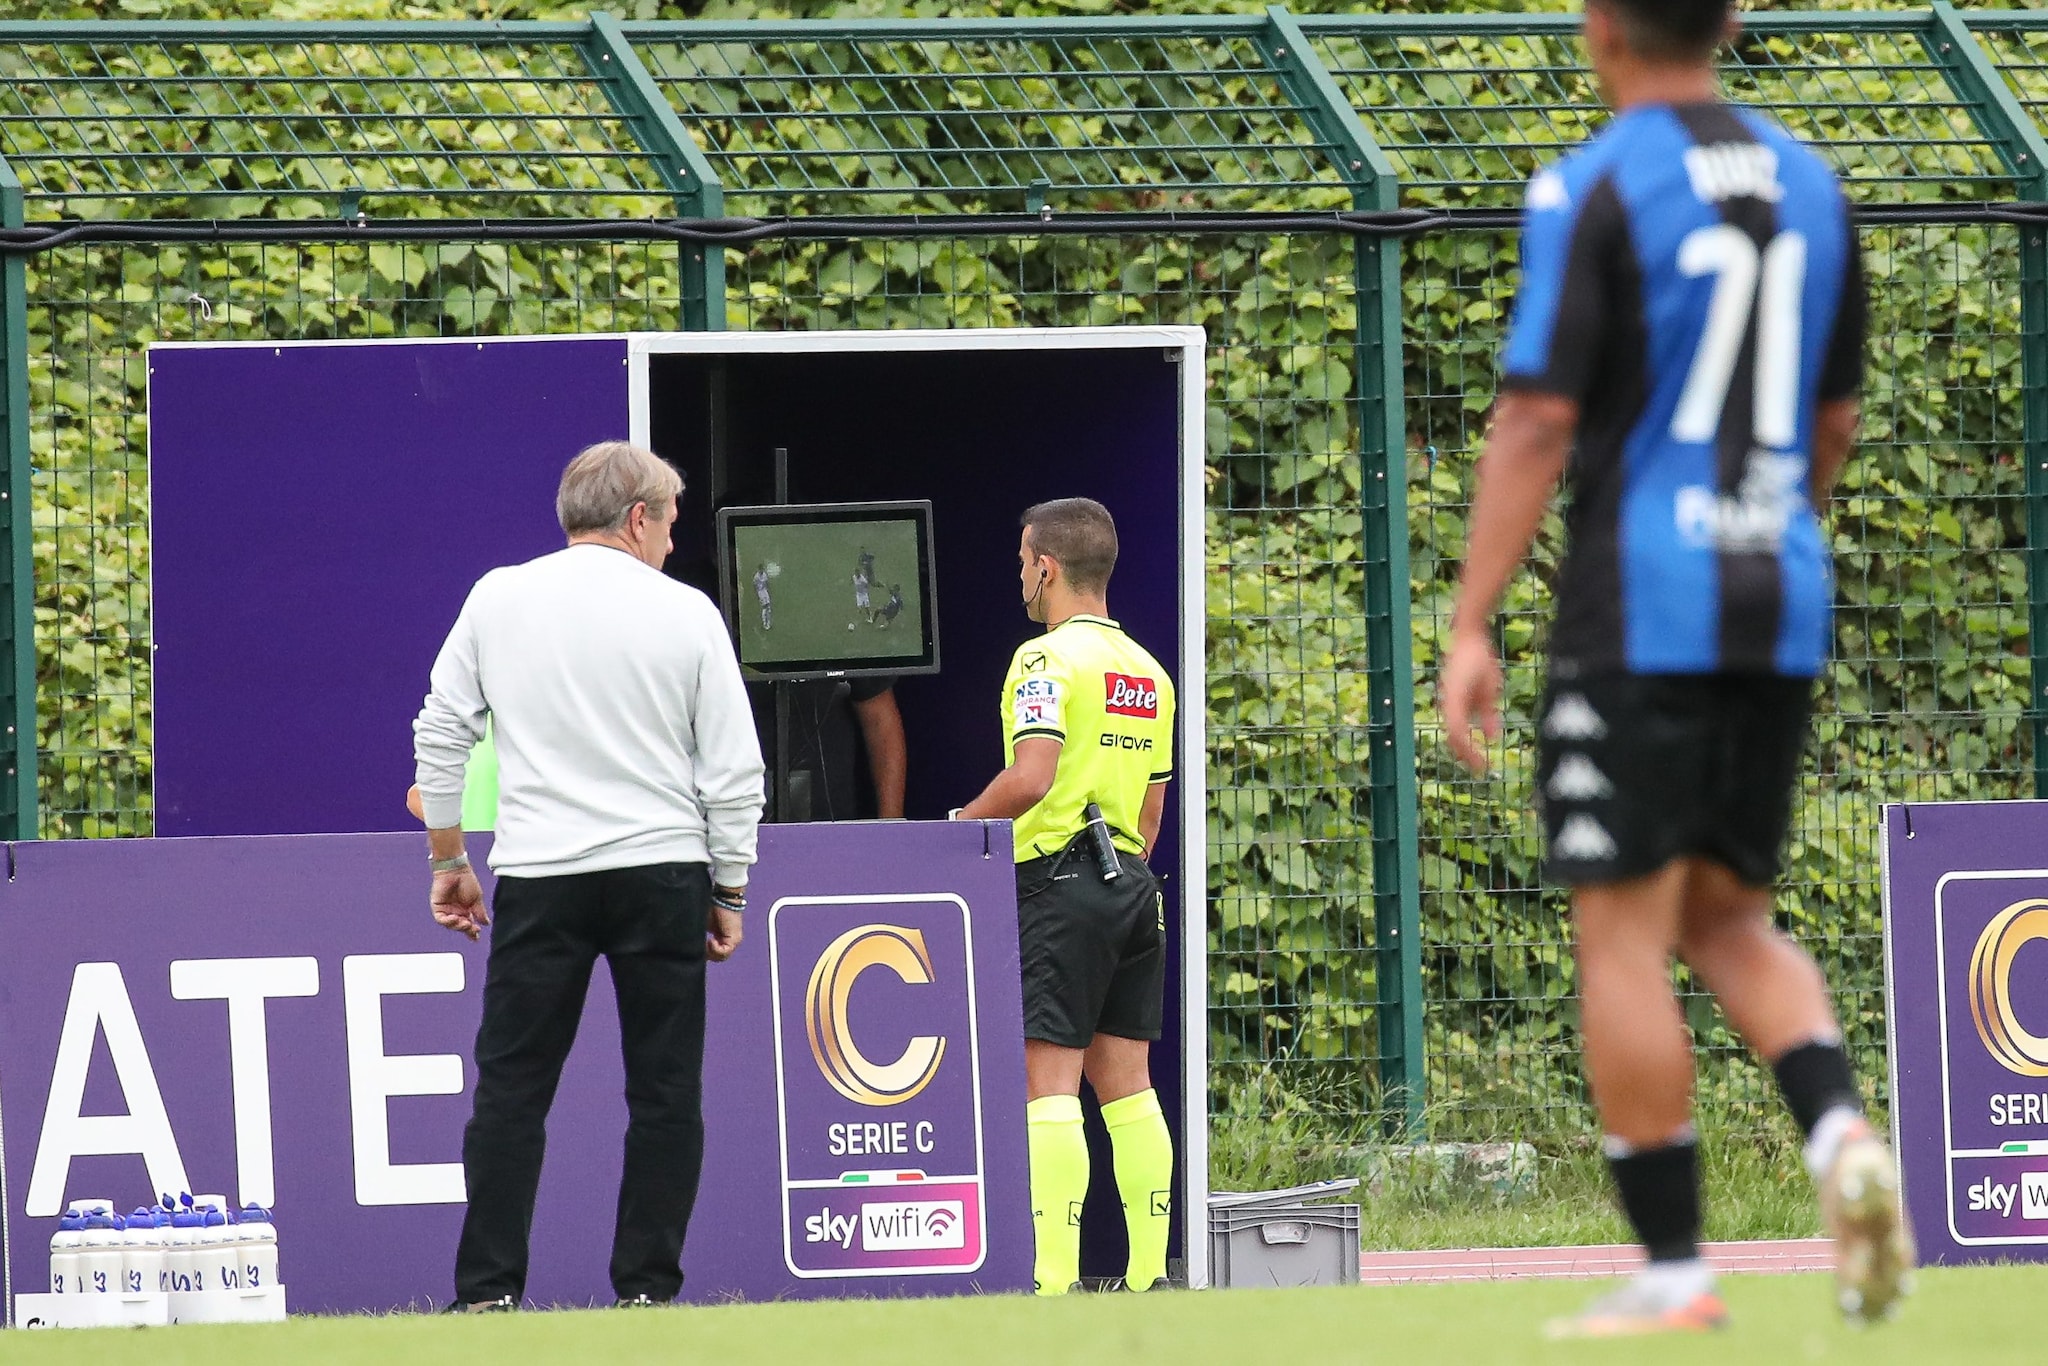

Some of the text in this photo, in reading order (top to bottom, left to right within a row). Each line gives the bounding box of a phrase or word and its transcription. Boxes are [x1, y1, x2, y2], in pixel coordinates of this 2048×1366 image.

[1670, 222, 1806, 447] 71
[1016, 680, 1055, 700] NET
[1106, 678, 1156, 709] Lete
[25, 952, 469, 1217] ATE
[1989, 1092, 2048, 1126] SERI
[828, 1120, 935, 1156] SERIE C
[1967, 1176, 2018, 1218] sky
[805, 1207, 921, 1249] sky wifi
